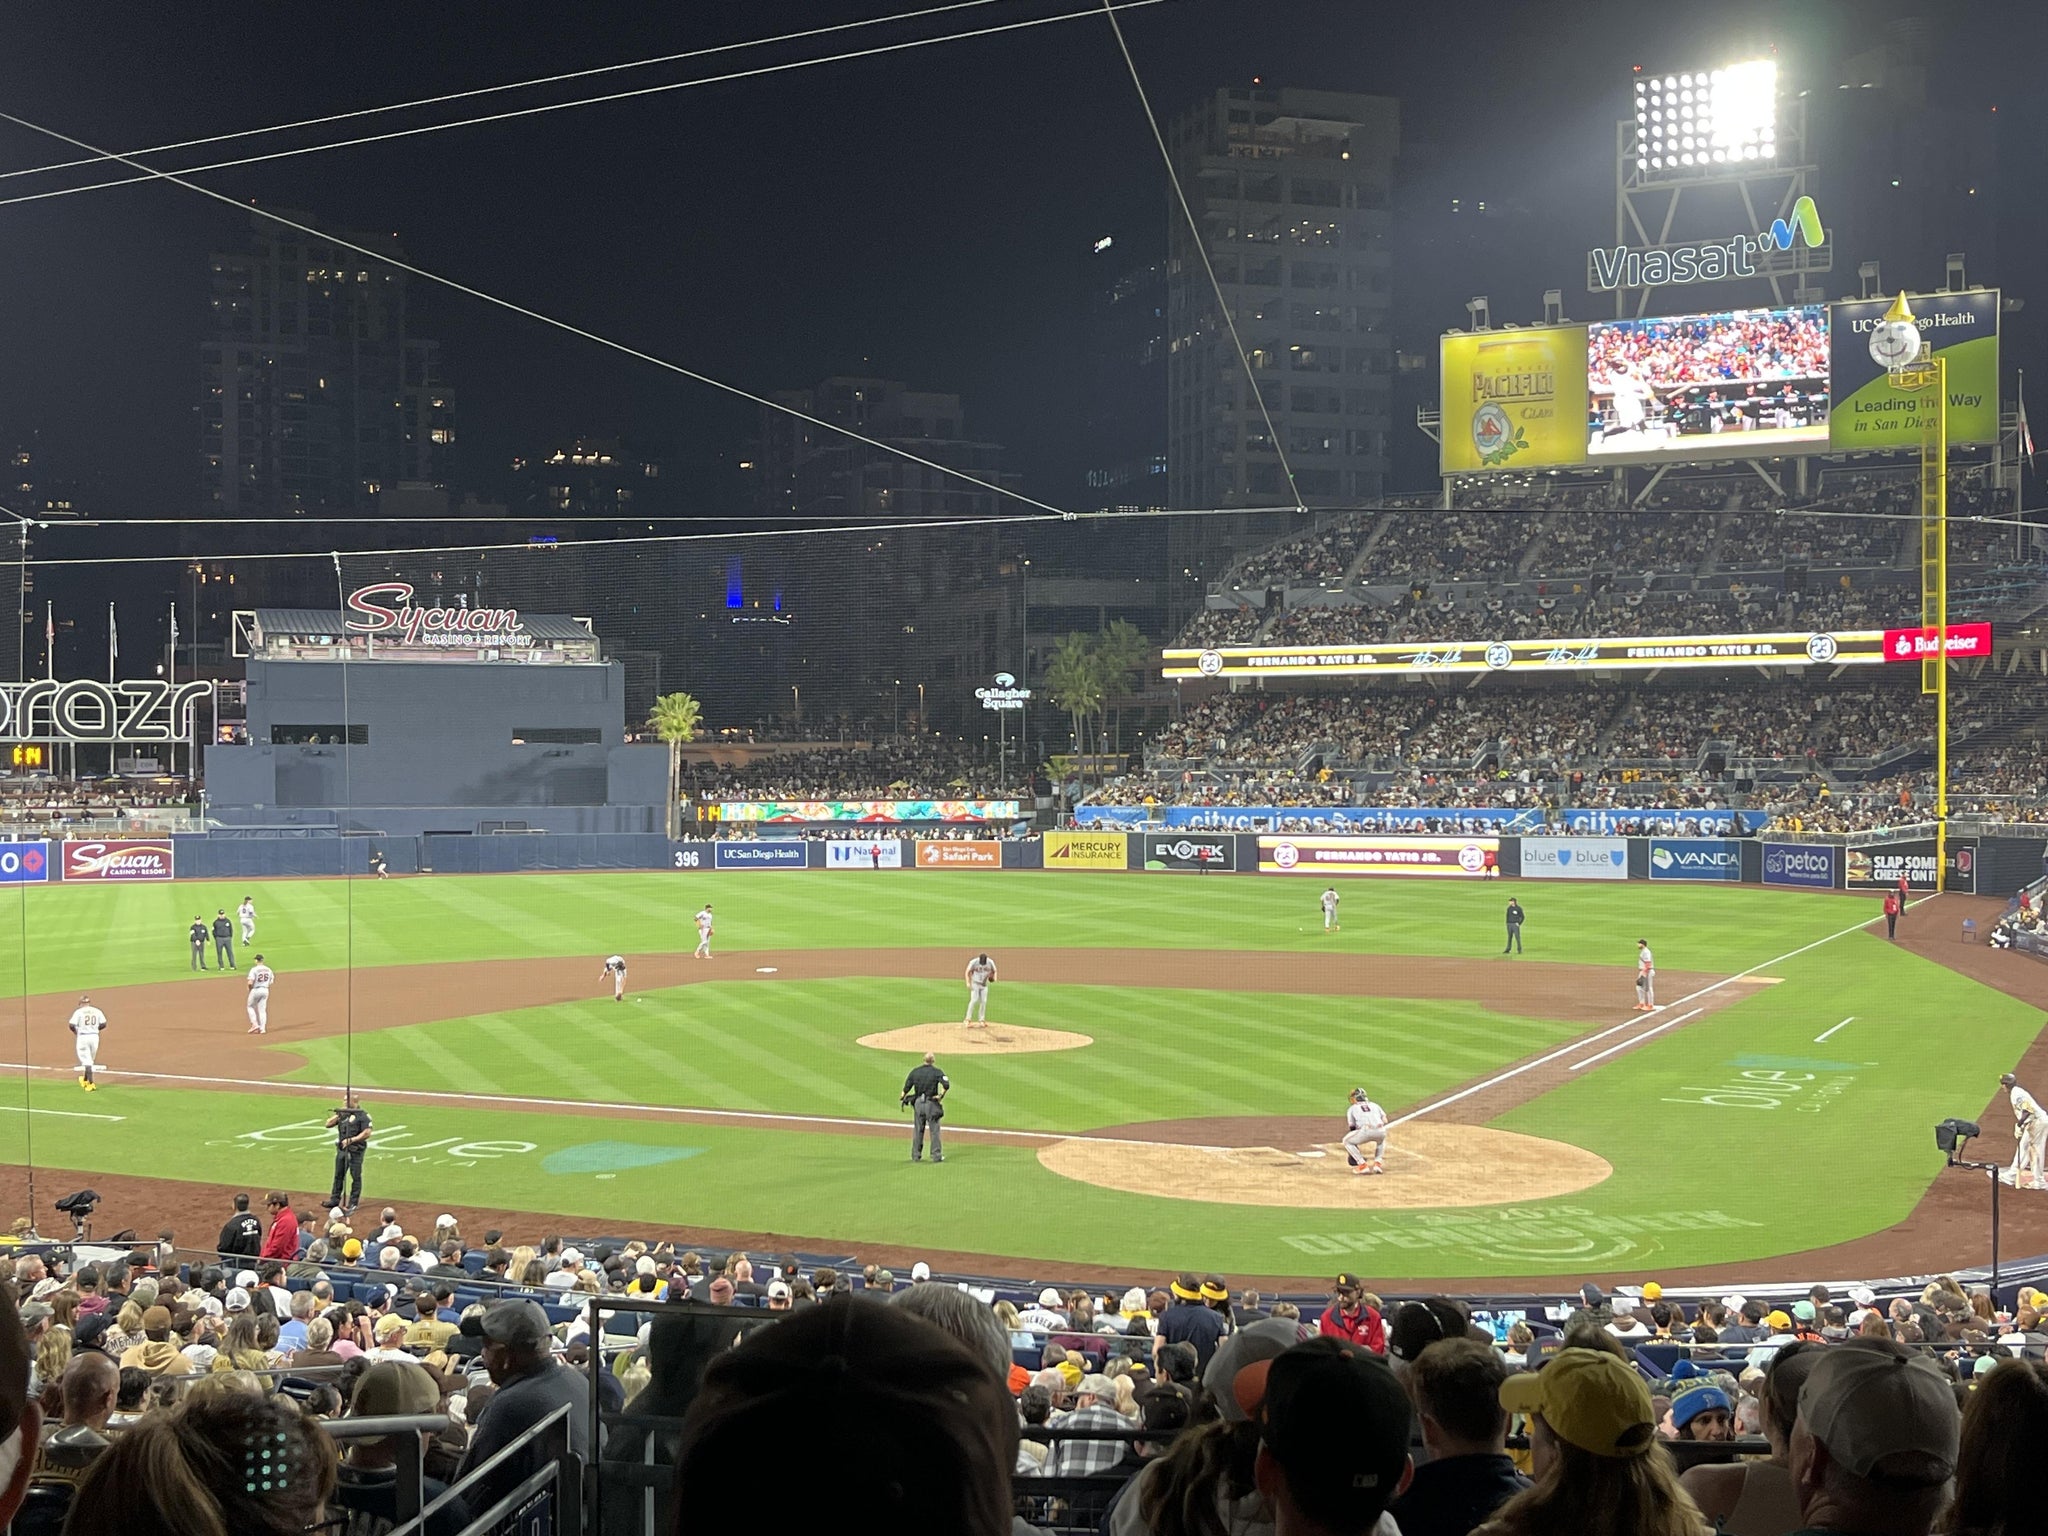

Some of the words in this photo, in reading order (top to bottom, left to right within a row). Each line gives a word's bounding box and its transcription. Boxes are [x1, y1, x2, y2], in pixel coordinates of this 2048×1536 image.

[1593, 234, 1756, 289] Viasat
[1935, 311, 1975, 327] Health
[1855, 398, 1917, 413] Leading
[1949, 393, 1982, 408] Way
[1854, 420, 1867, 432] in
[1873, 417, 1898, 430] San
[345, 582, 524, 645] Sycuan
[422, 634, 474, 646] CASINO
[484, 634, 532, 646] RESORT
[1627, 646, 1706, 658] FERNANDO
[1709, 644, 1751, 655] TATIS
[1755, 644, 1777, 655] JR.
[1811, 639, 1831, 657] 23
[1248, 655, 1317, 667] FERNANDO
[1318, 654, 1355, 665] TATIS
[1357, 654, 1377, 665] JR.
[1488, 647, 1509, 667] 23
[975, 687, 1031, 699] Gallagher
[16, 679, 213, 740] razr
[983, 698, 1023, 710] Square
[1071, 842, 1121, 851] MERCURY
[71, 844, 163, 877] Sycuan
[675, 851, 699, 867] 396
[724, 849, 737, 859] UC
[737, 849, 752, 859] San
[752, 849, 774, 860] Diego
[774, 849, 799, 859] Health
[942, 852, 971, 861] Safari
[971, 852, 994, 862] Park
[1071, 850, 1122, 860] INSURANCE
[1315, 850, 1382, 861] FERNANDO
[1524, 849, 1557, 863] blue
[1577, 851, 1610, 865] blue
[1674, 852, 1740, 866] VANDA
[1785, 851, 1829, 873] petco
[1873, 855, 1904, 869] SLAP
[1911, 869, 1927, 881] ON
[257, 973, 269, 983] 26
[84, 1015, 97, 1026] 20
[1279, 1218, 1585, 1256] OPENING
